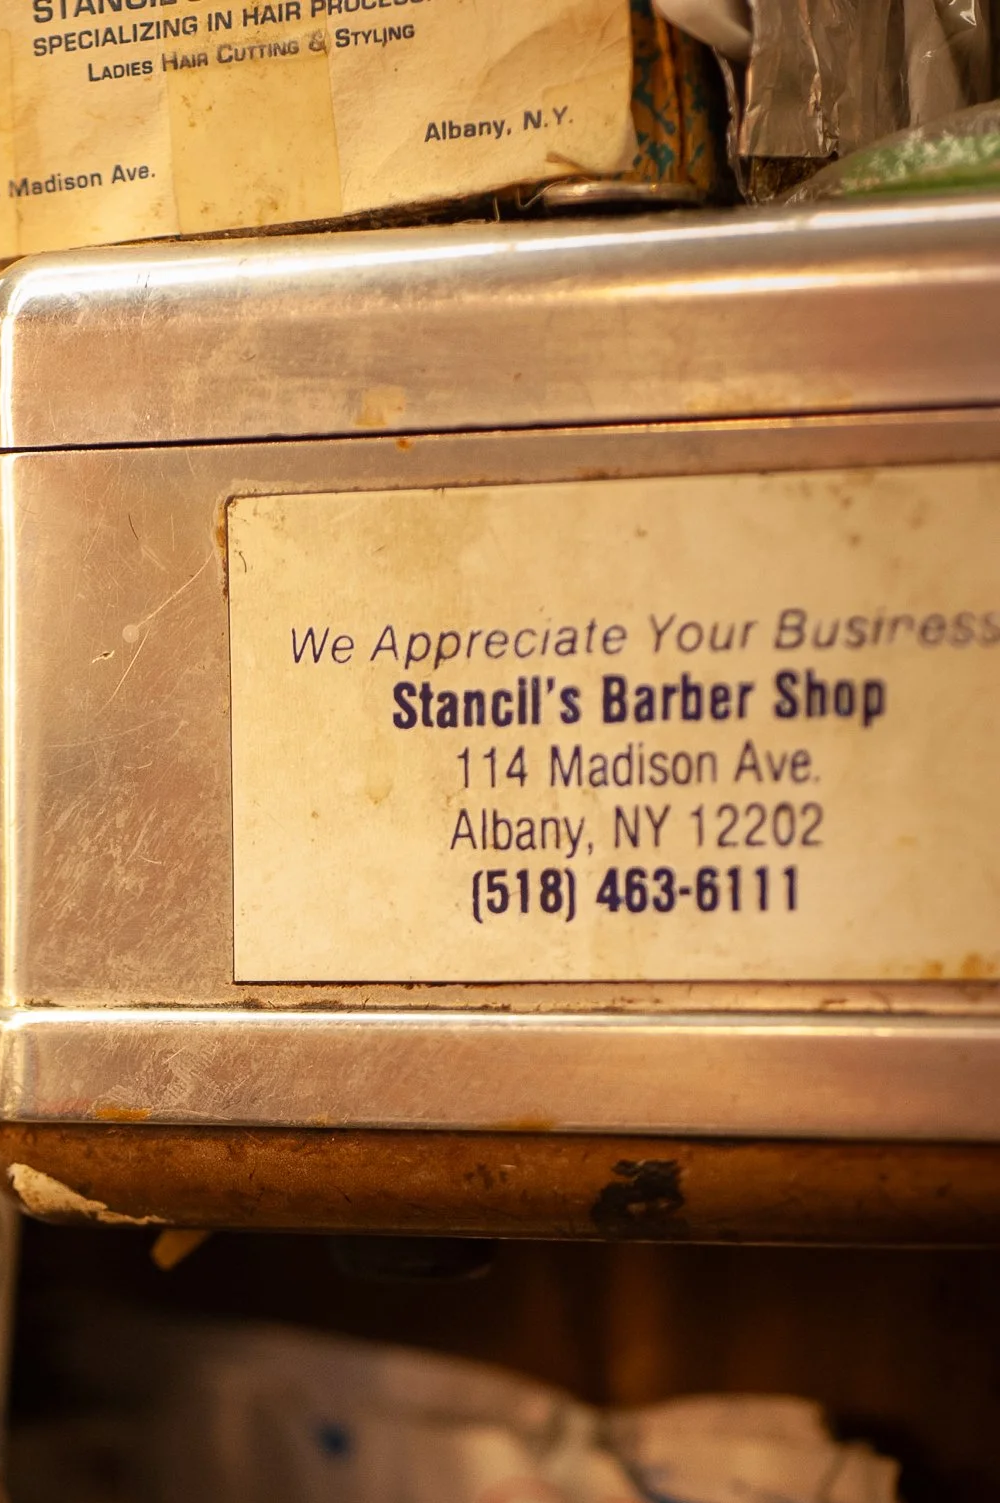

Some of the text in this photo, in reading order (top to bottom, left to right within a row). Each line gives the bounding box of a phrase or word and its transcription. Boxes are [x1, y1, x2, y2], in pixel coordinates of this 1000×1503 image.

[33, 15, 198, 57] SPECIALIZING
[207, 10, 233, 33] IN
[242, 2, 302, 27] HAIR
[308, 29, 328, 52] &
[424, 105, 574, 143] Albany, N.Y.
[8, 171, 103, 199] Madison
[111, 164, 157, 184] Ave.
[290, 606, 1000, 670] We Appreciate Your Business
[392, 668, 889, 731] Stancil's Barber Shop
[456, 738, 822, 790] 114 Madison Ave.
[450, 801, 825, 860] Albany, NY 12202
[471, 864, 799, 924] (518) 463-6111
